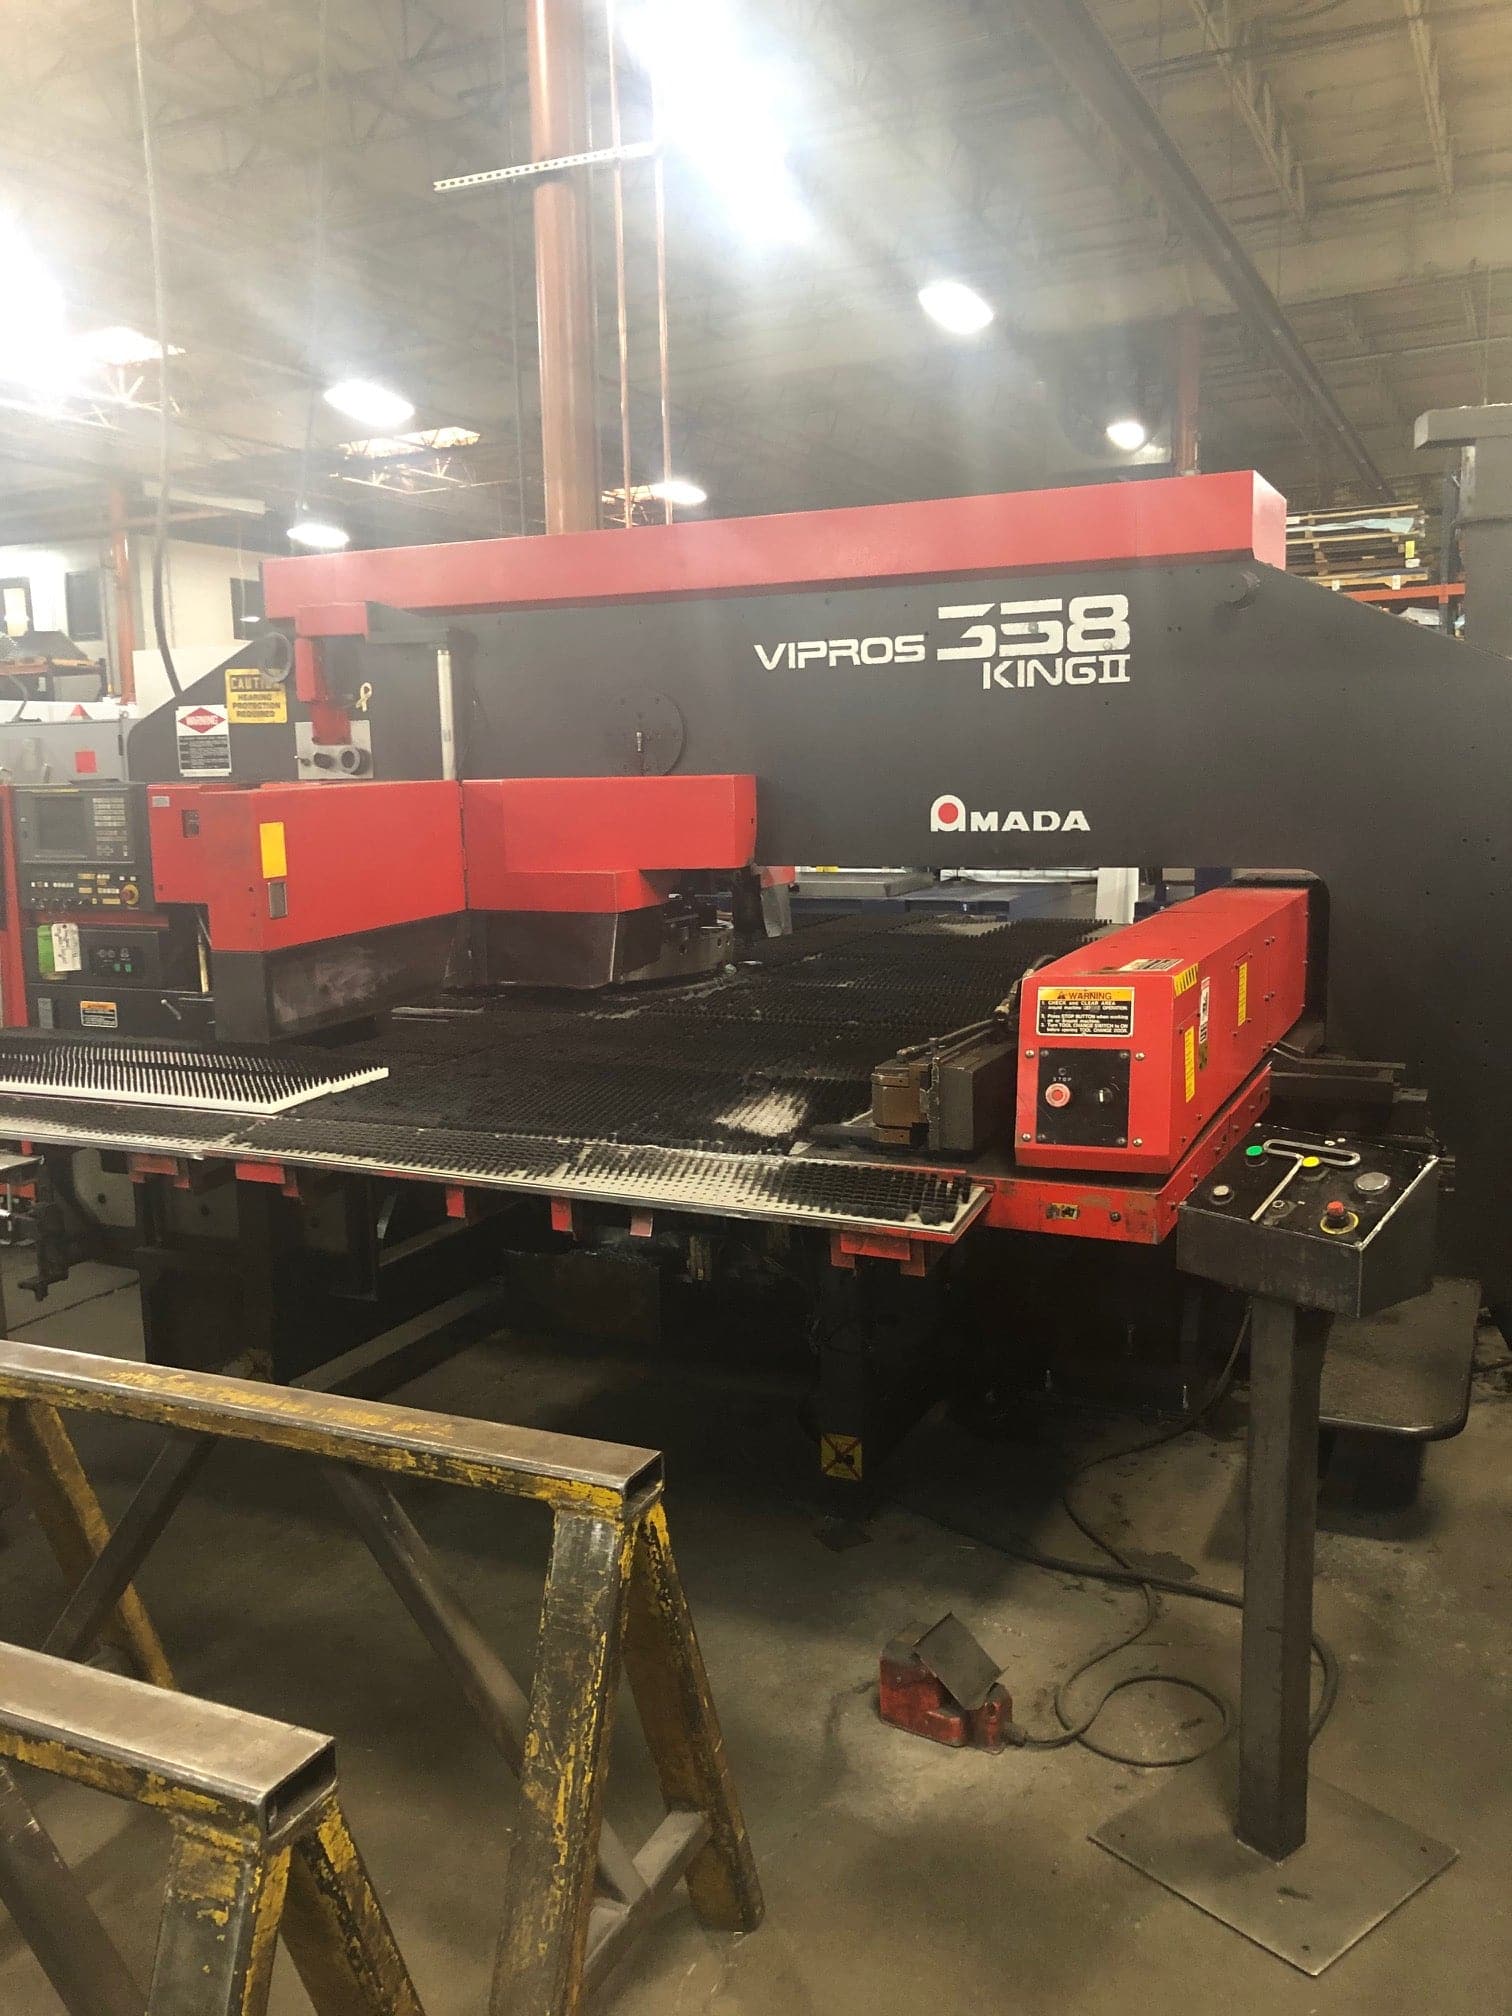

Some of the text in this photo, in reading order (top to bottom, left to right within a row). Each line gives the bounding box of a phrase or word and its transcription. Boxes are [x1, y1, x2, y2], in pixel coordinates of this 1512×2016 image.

[753, 594, 1131, 671] VIPROS 358
[232, 702, 281, 710] PROTECTION
[930, 794, 1091, 832] AMADA
[1069, 991, 1112, 1000] WARNING
